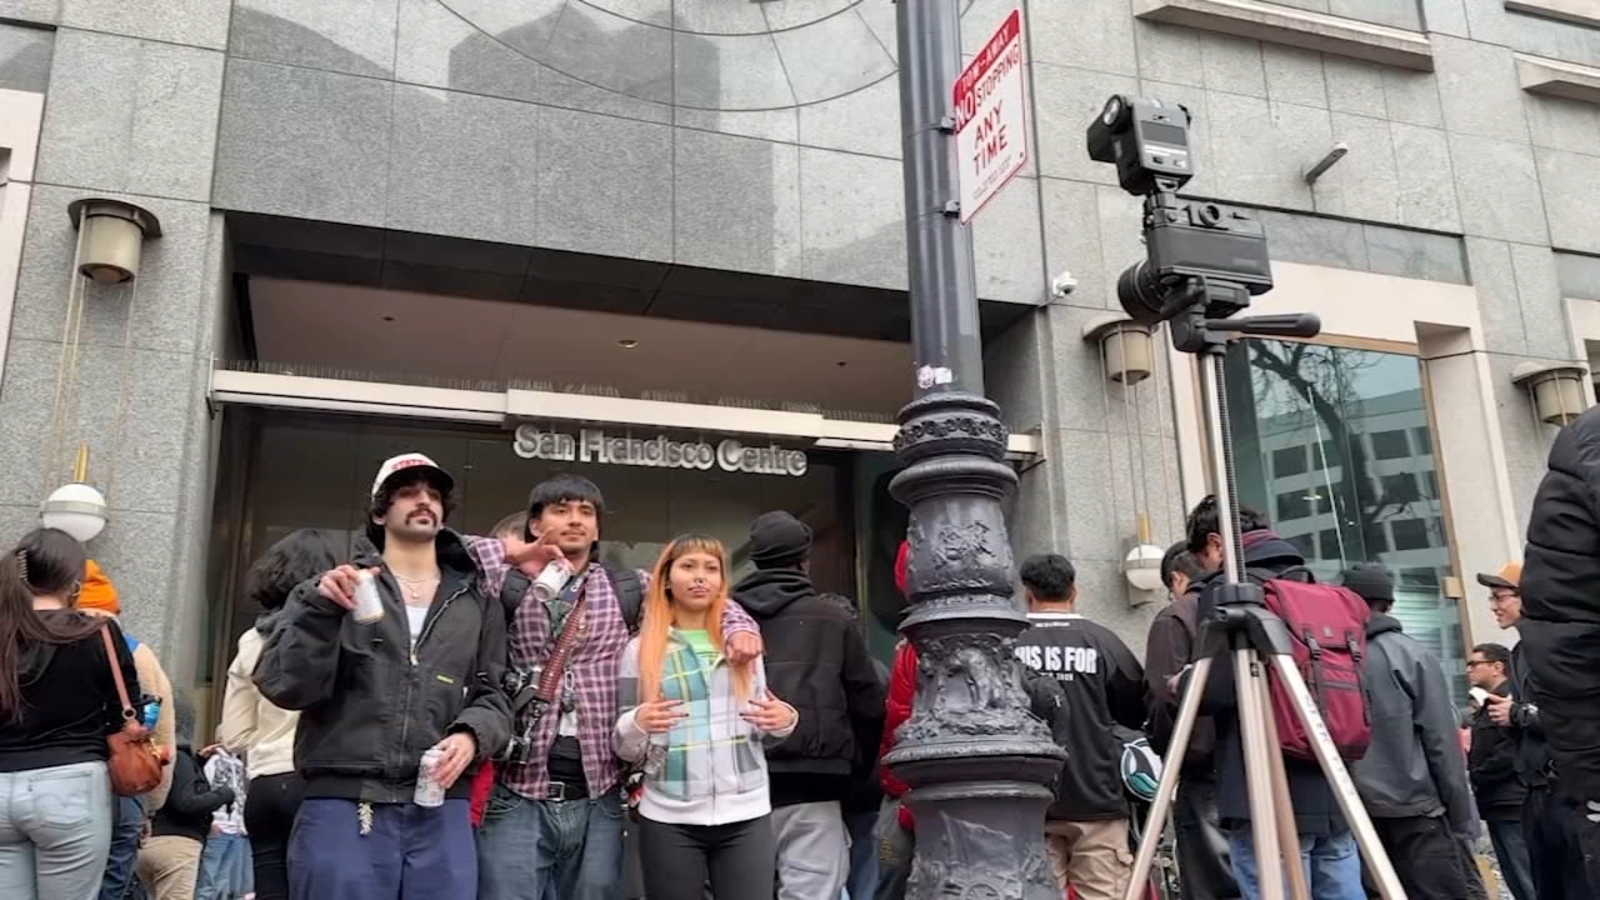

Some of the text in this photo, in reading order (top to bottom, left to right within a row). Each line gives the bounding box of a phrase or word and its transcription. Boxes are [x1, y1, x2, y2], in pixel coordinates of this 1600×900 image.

[955, 43, 1019, 131] NO STOPPING
[973, 124, 1008, 175] TIME
[974, 100, 1003, 149] ANY
[513, 423, 808, 476] San Francisco Centre
[1014, 645, 1097, 674] HIS IS FOR
